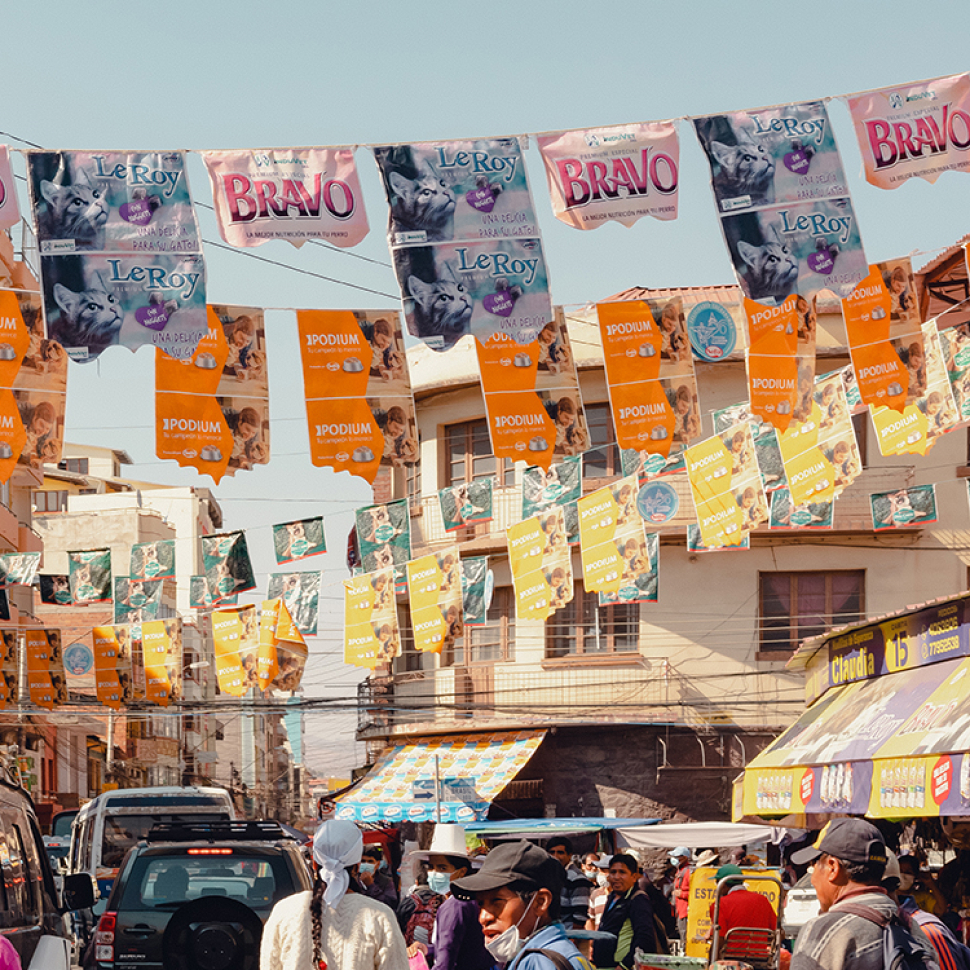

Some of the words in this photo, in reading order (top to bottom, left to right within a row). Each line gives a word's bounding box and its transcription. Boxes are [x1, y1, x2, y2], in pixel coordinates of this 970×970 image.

[751, 114, 825, 143] LeRoy
[861, 102, 970, 172] BRAVO
[93, 156, 182, 197] LeRoy
[434, 147, 517, 181] LeRoy
[552, 146, 678, 211] BRAVO
[217, 171, 356, 225] BRAVO
[778, 211, 851, 242] LeRoy
[107, 260, 199, 299] LeRoy
[455, 249, 538, 283] LeRoy
[313, 335, 359, 345] PODIUM
[612, 321, 652, 334] PODIUM
[758, 379, 795, 388] PODIUM
[864, 361, 899, 378] PODIUM
[502, 414, 545, 426] PODIUM
[625, 403, 666, 418] PODIUM
[886, 413, 918, 437] PODIUM
[170, 419, 221, 432] PODIUM
[321, 424, 371, 435] PODIUM
[796, 462, 825, 482] PODIUM
[895, 631, 908, 667] 15
[832, 647, 874, 684] Claudia
